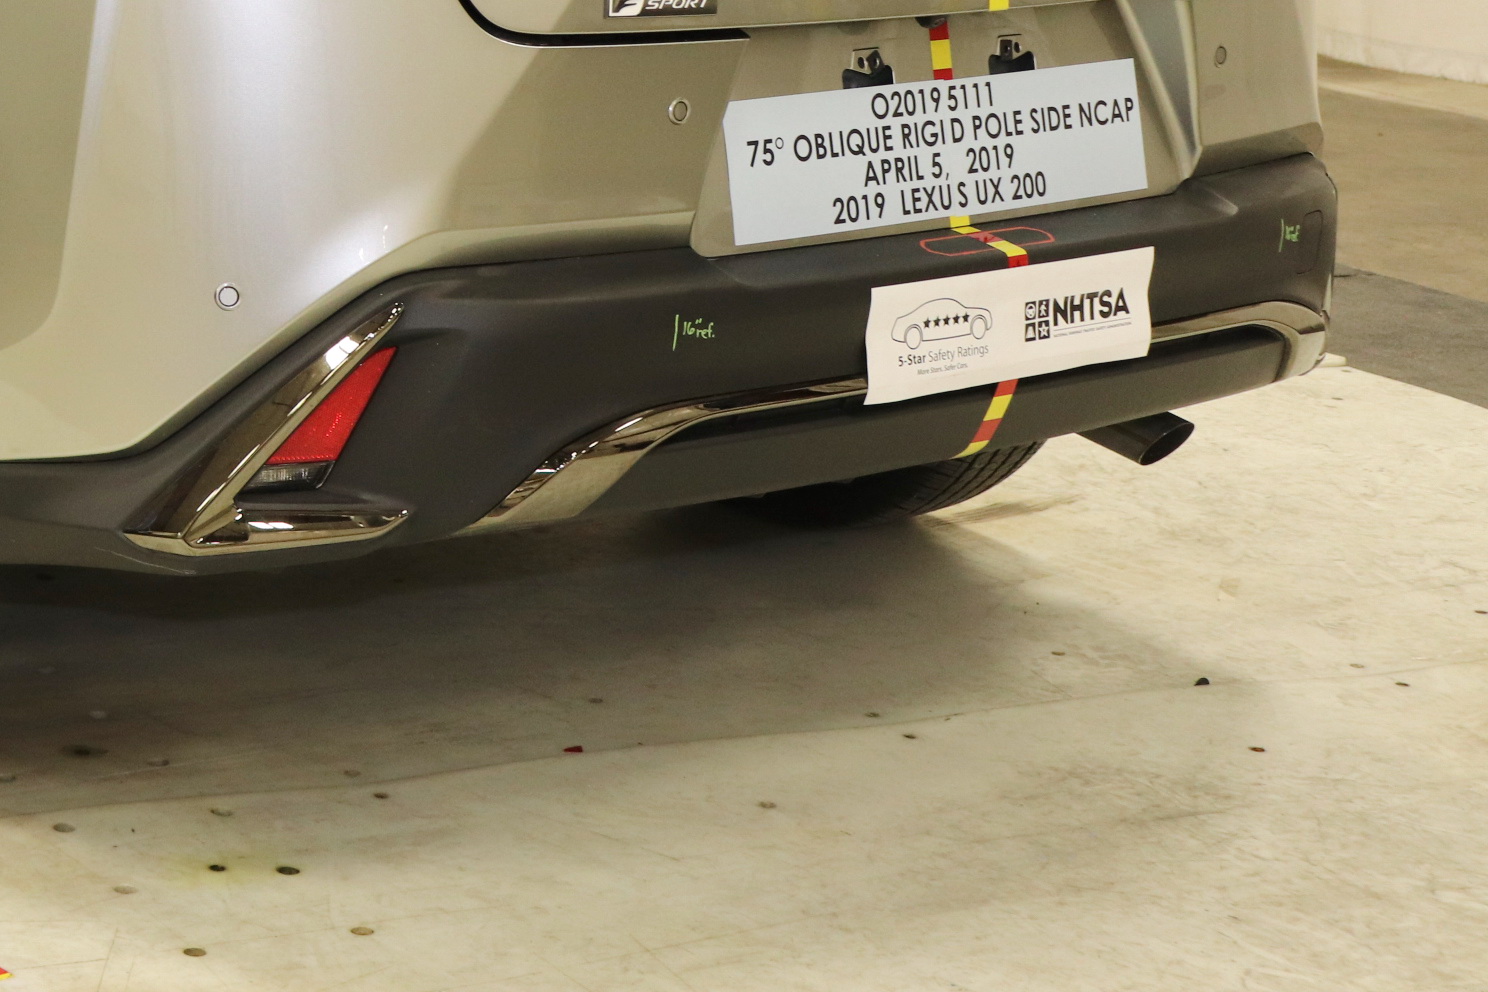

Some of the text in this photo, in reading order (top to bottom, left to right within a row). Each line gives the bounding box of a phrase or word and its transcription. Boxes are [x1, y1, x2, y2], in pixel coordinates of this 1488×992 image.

[793, 125, 894, 162] OBLIQUE
[901, 117, 965, 150] RIGID
[972, 110, 1024, 141] POLE
[1030, 104, 1073, 134] SIDE
[1078, 97, 1134, 128] NCAP
[864, 143, 1014, 188] APRIL 5, 2019
[832, 171, 1046, 225] 2019 LEXUS UX 200
[1053, 287, 1130, 326] NHTSA
[898, 344, 989, 367] 5-Star Safety Ratings
